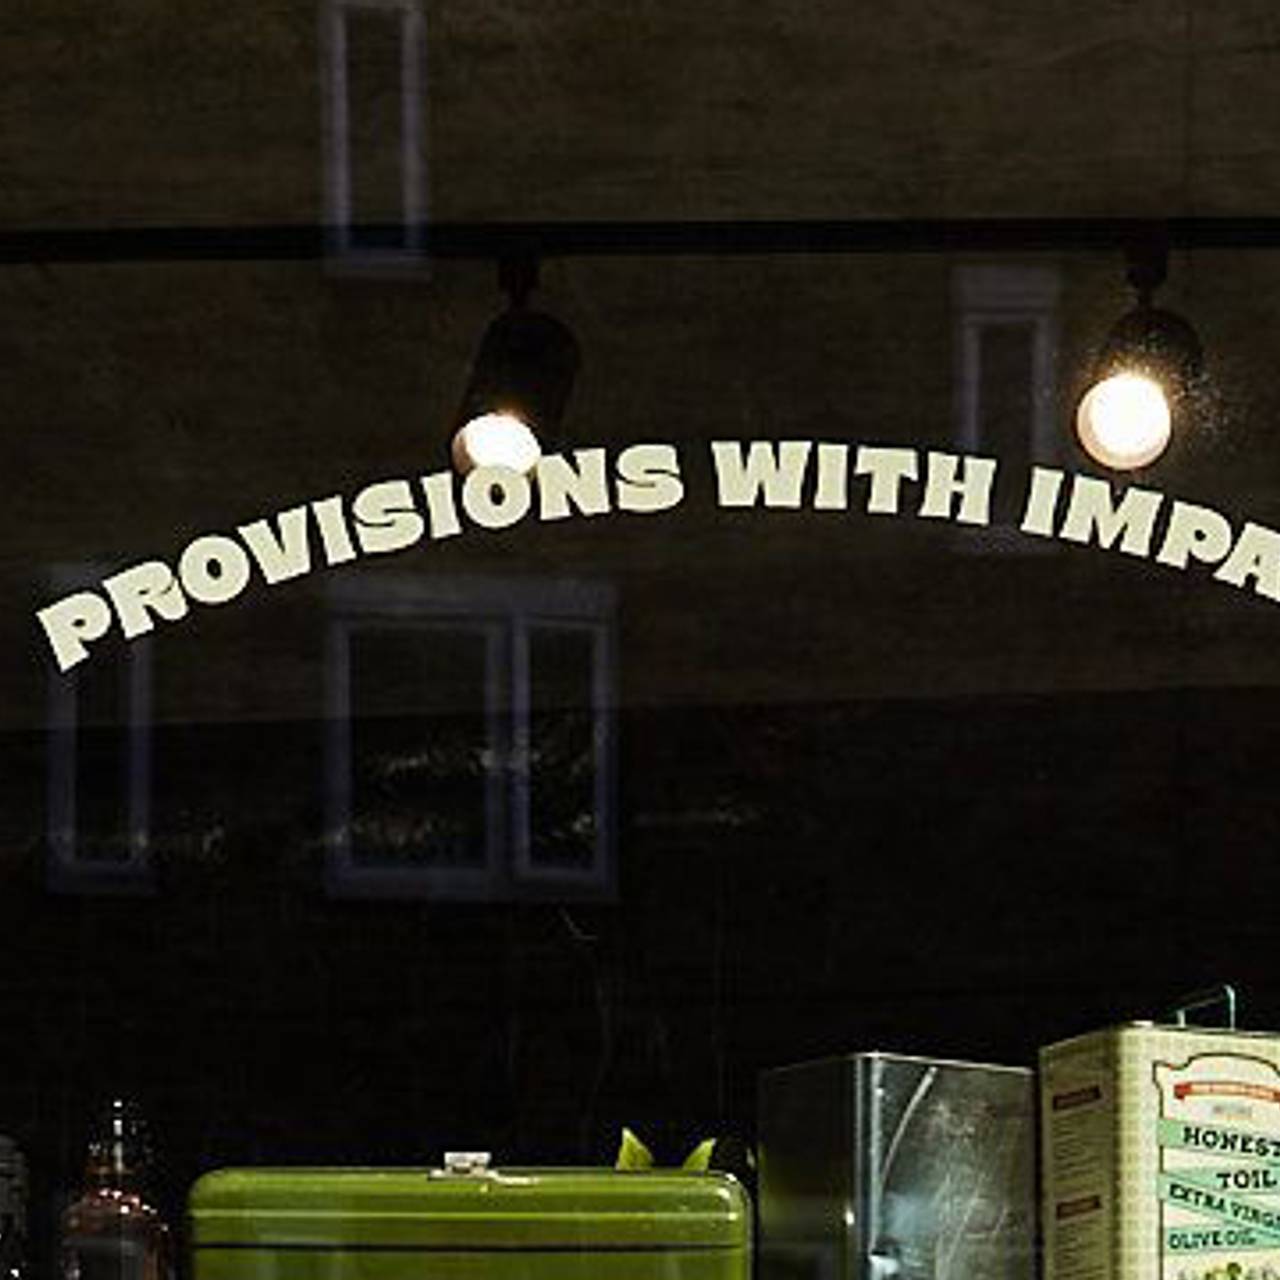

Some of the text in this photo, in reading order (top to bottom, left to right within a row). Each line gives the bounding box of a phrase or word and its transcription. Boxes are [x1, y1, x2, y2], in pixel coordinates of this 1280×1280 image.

[37, 444, 684, 671] PROVISIONS
[712, 440, 997, 525] WITH
[1216, 1169, 1278, 1190] TOIL
[1169, 1183, 1227, 1213] EXTRA
[1168, 1230, 1223, 1249] OLIVE
